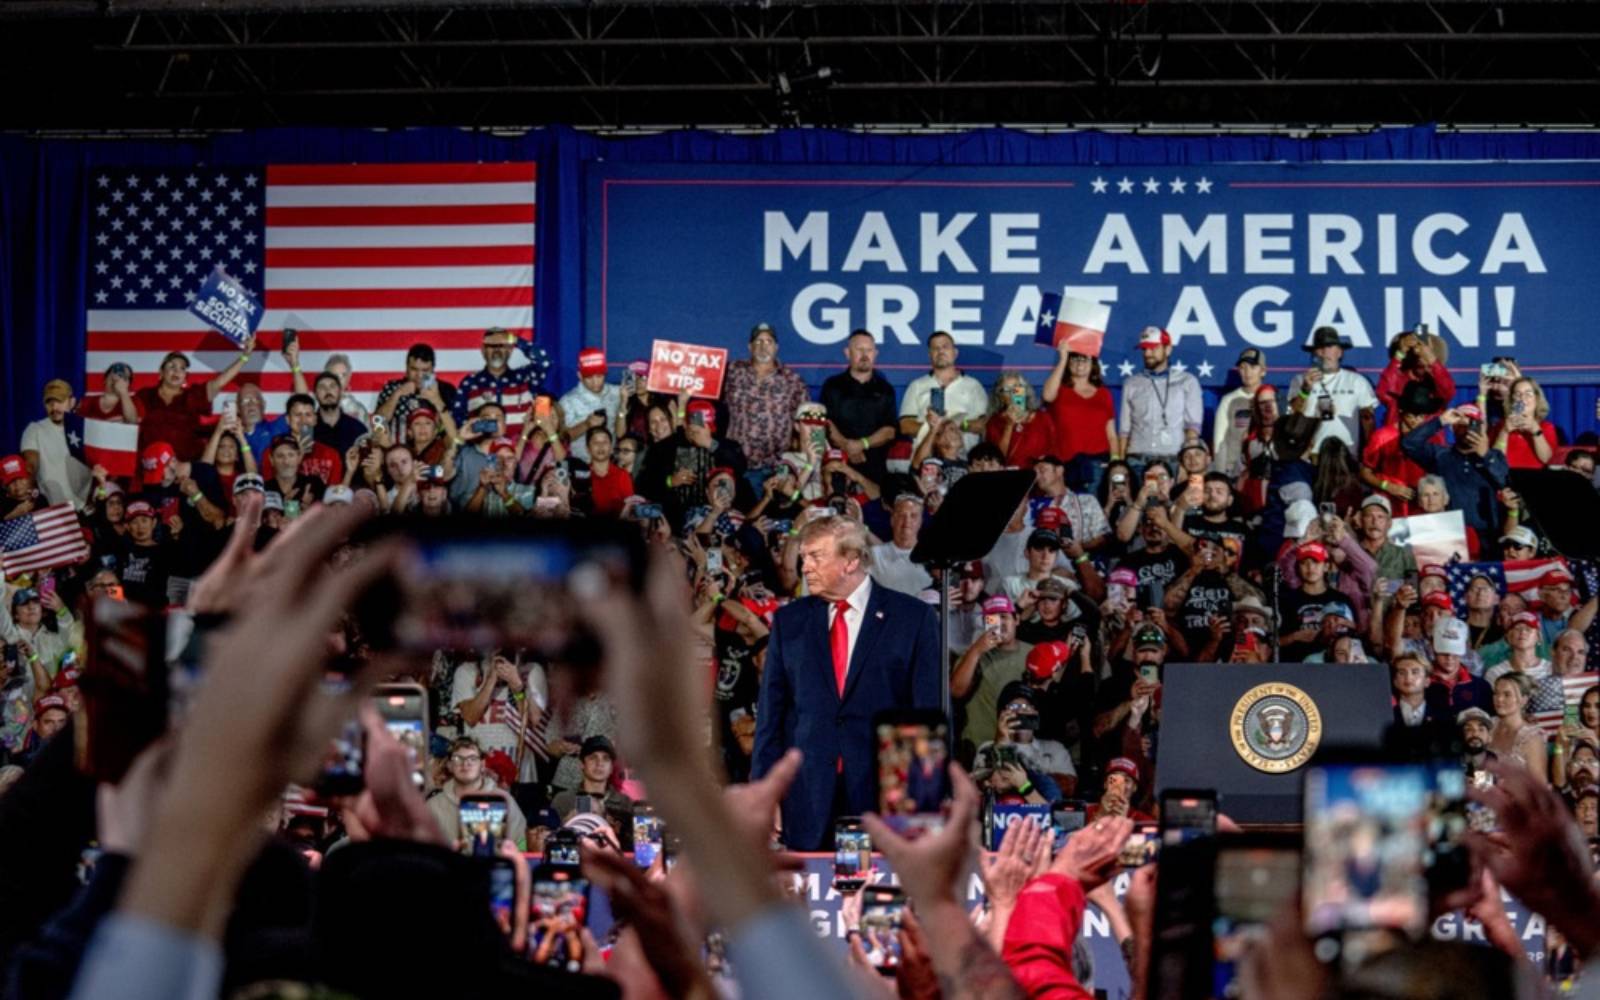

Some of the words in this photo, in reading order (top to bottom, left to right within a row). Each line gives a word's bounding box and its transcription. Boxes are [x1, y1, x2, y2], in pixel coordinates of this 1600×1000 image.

[765, 212, 1040, 273] MAKE
[1084, 212, 1547, 275] AMERICA
[208, 295, 248, 331] SOCIAL
[217, 280, 236, 299] NO
[236, 293, 256, 316] TAX
[195, 300, 250, 341] SECURITY
[1166, 285, 1515, 348] AGAIN!
[657, 346, 684, 365] NO
[687, 351, 723, 369] TAX
[667, 374, 705, 391] TIPS
[993, 813, 1025, 829] NO
[1027, 813, 1052, 829] TA
